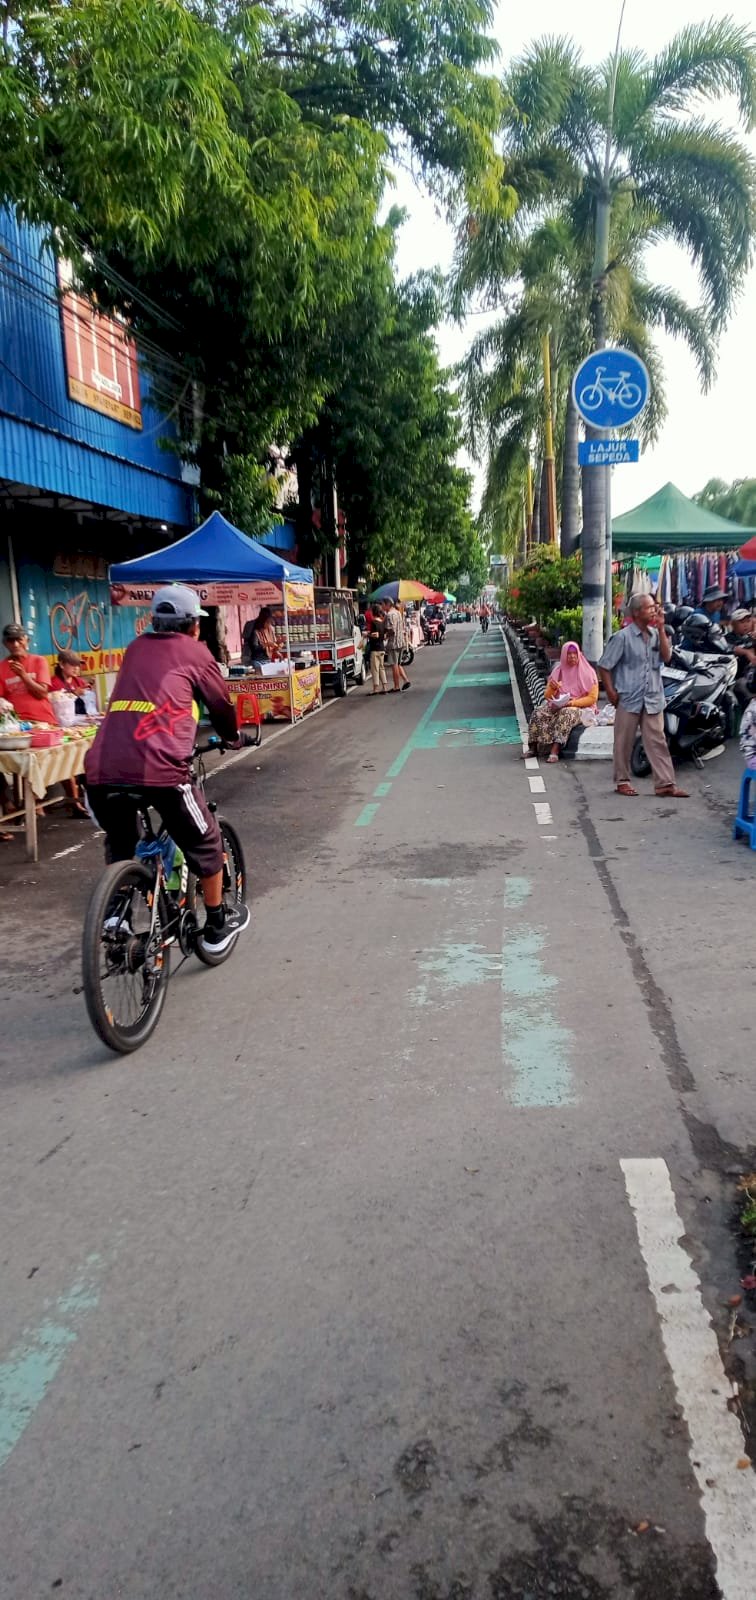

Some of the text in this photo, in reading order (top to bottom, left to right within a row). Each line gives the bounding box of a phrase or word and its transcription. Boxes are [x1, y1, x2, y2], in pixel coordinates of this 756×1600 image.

[590, 443, 627, 452] LAJUR
[588, 453, 631, 463] SEPEDA
[251, 682, 287, 692] BENING
